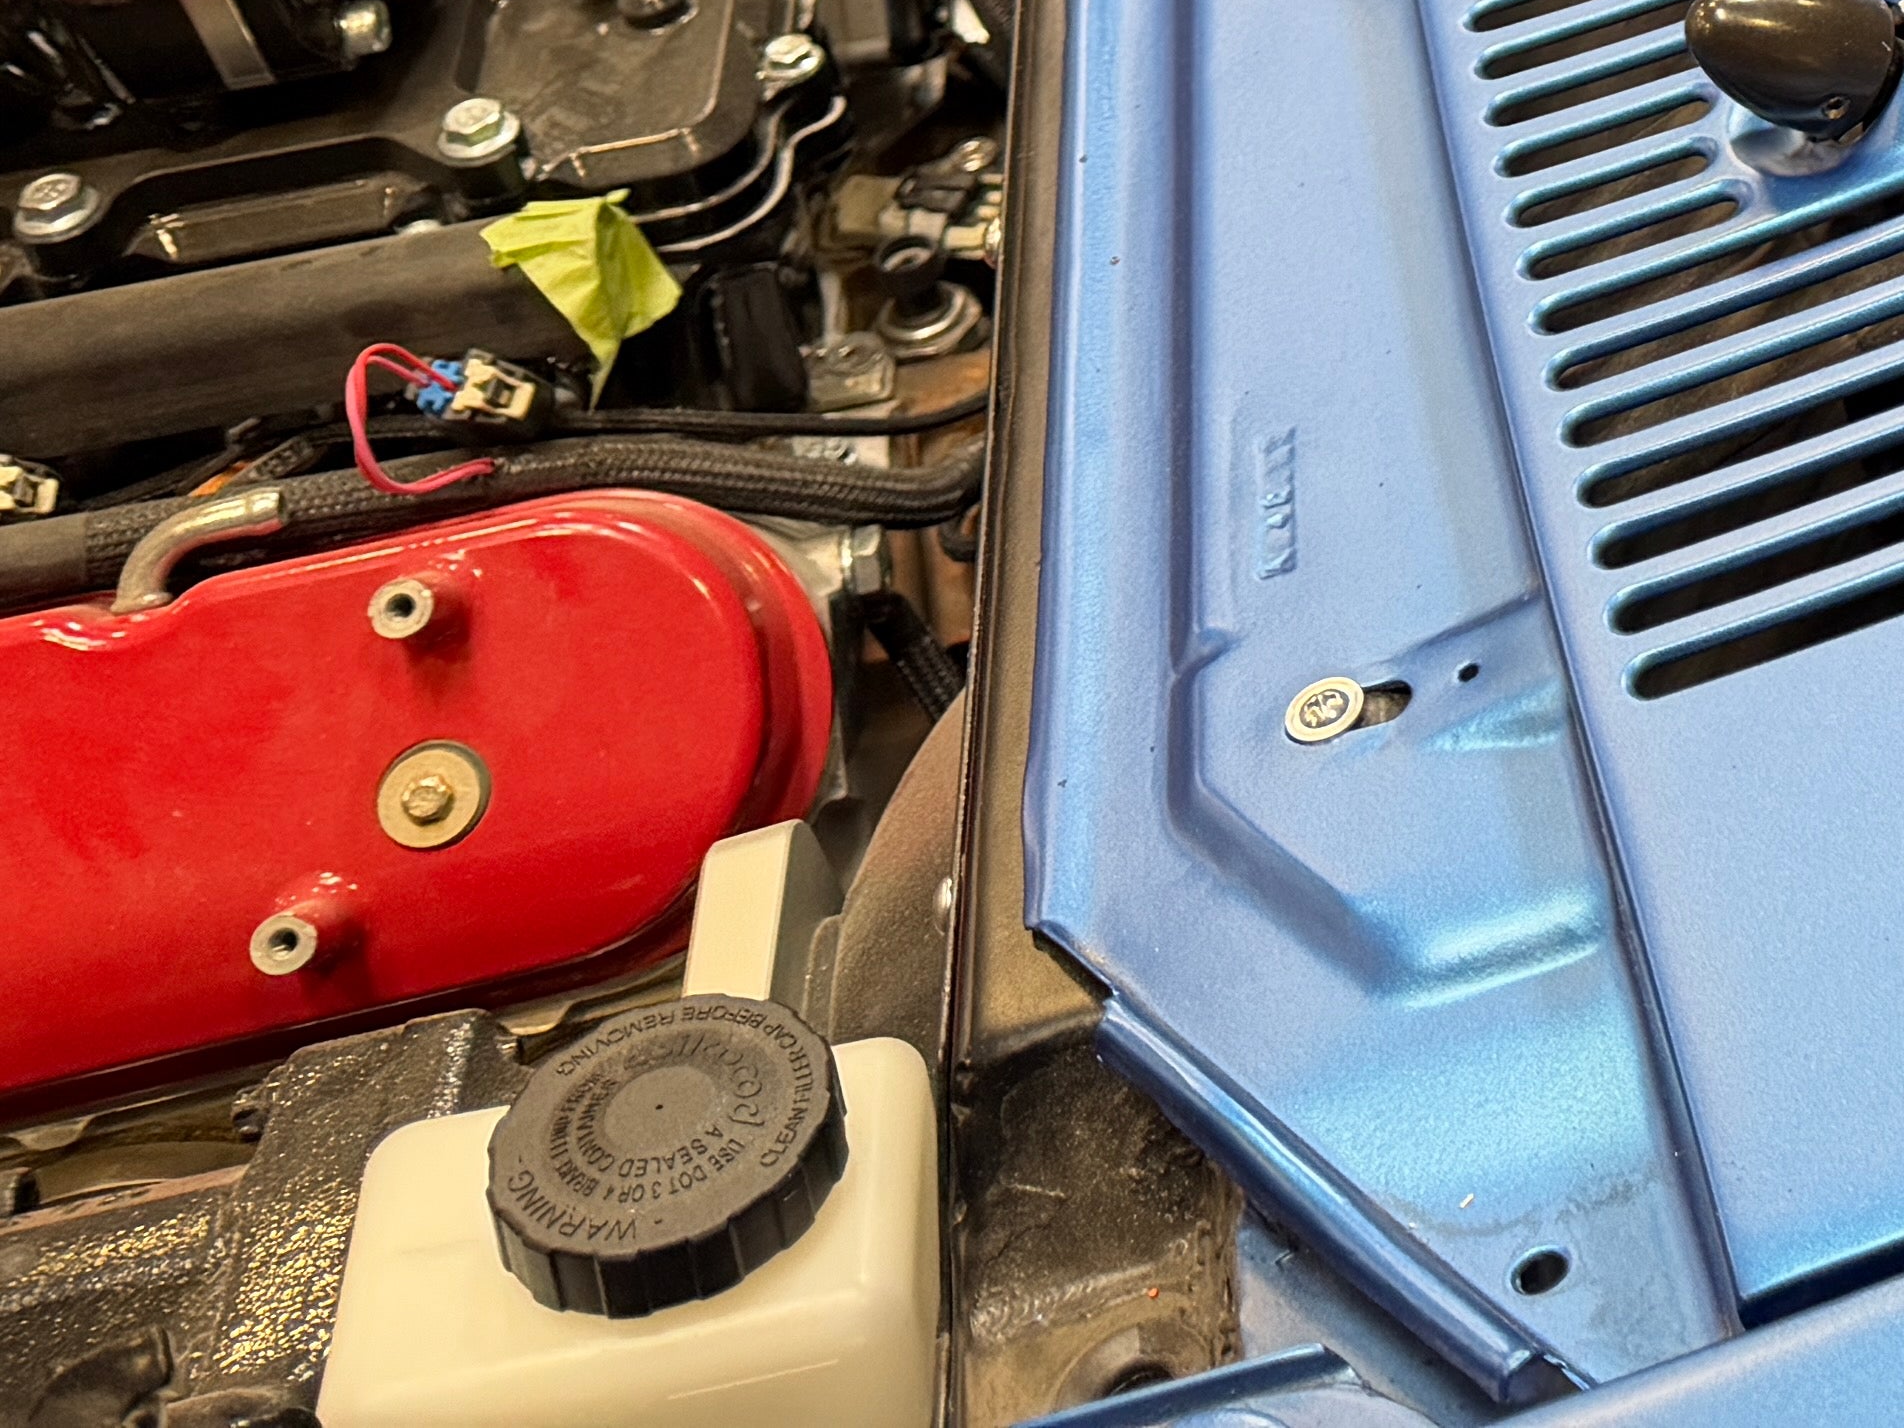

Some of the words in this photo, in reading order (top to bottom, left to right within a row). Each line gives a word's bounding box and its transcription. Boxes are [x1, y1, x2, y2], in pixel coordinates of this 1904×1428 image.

[681, 1006, 768, 1029] BEFORE
[556, 1010, 676, 1076] REMOVING
[763, 1024, 798, 1049] CAP
[705, 1124, 724, 1139] A
[759, 1104, 808, 1167] CLEAN
[618, 1138, 709, 1177] SEALED
[709, 1137, 746, 1172] USE
[618, 1183, 645, 1204] OR
[650, 1180, 662, 1200] 3
[667, 1164, 708, 1196] DOT
[507, 1169, 637, 1243] WARNING
